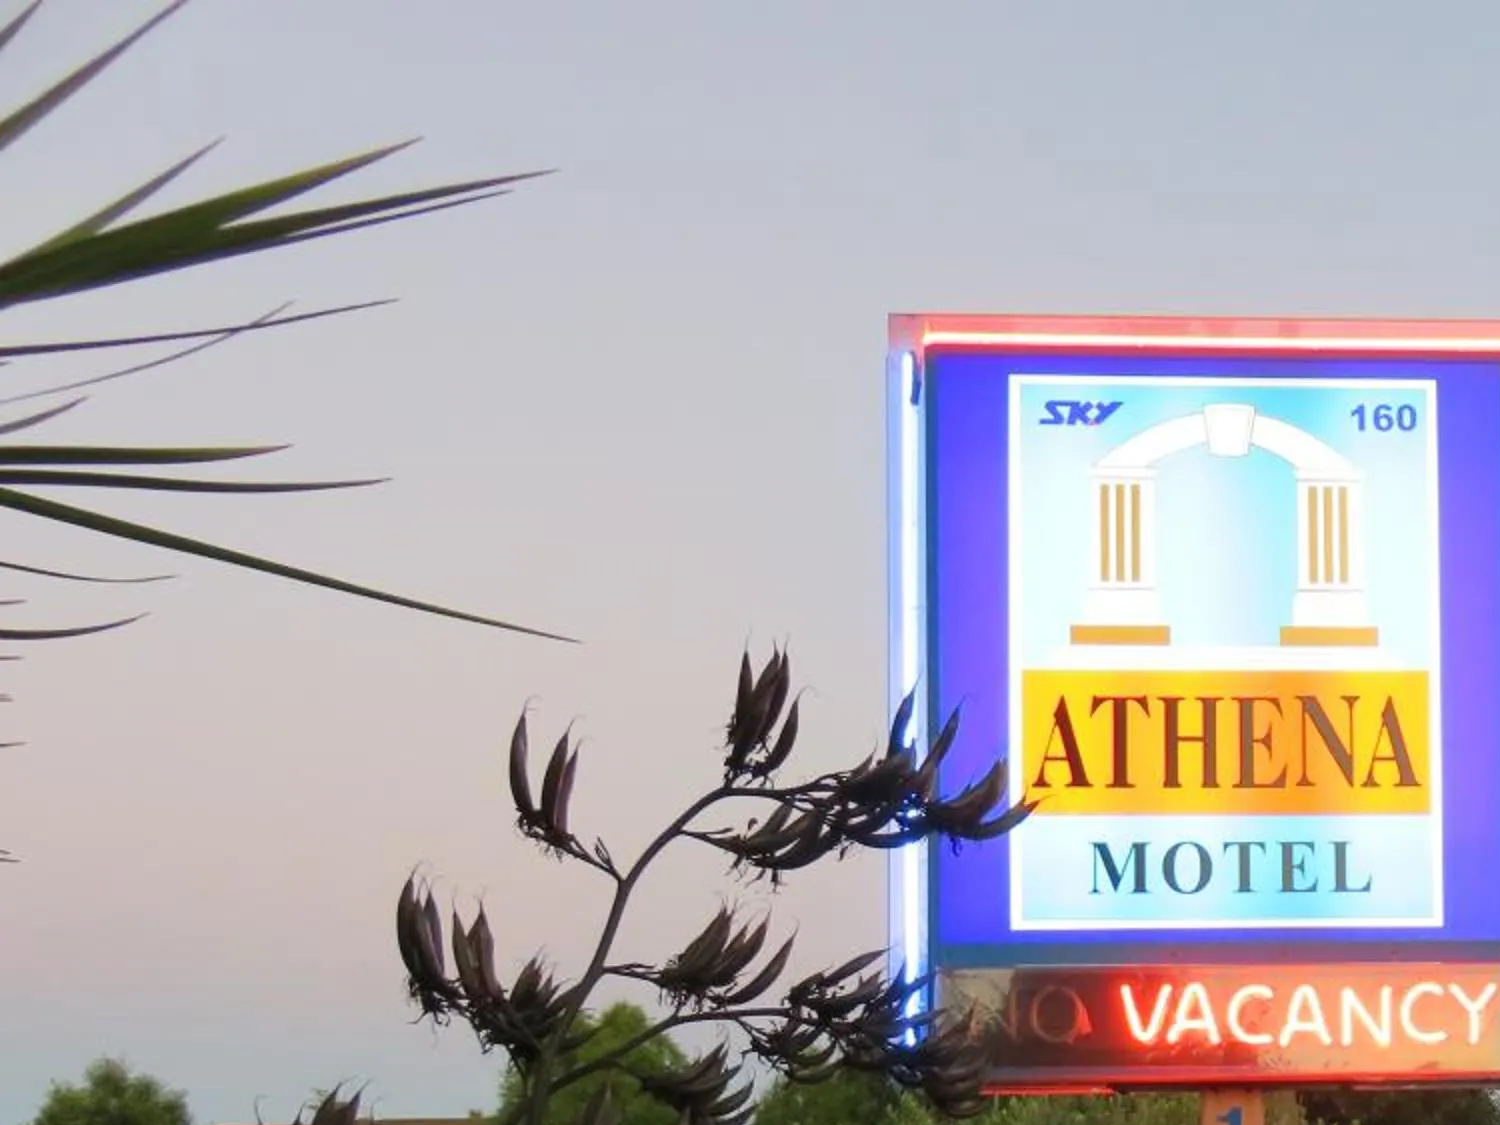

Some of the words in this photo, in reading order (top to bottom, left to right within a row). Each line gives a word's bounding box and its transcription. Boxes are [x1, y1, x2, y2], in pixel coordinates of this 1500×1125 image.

[1039, 400, 1123, 425] SKY
[1350, 404, 1417, 432] 160
[1032, 694, 1421, 789] ATHENA
[1090, 840, 1372, 894] MOTEL
[1120, 982, 1497, 1047] VACANCY
